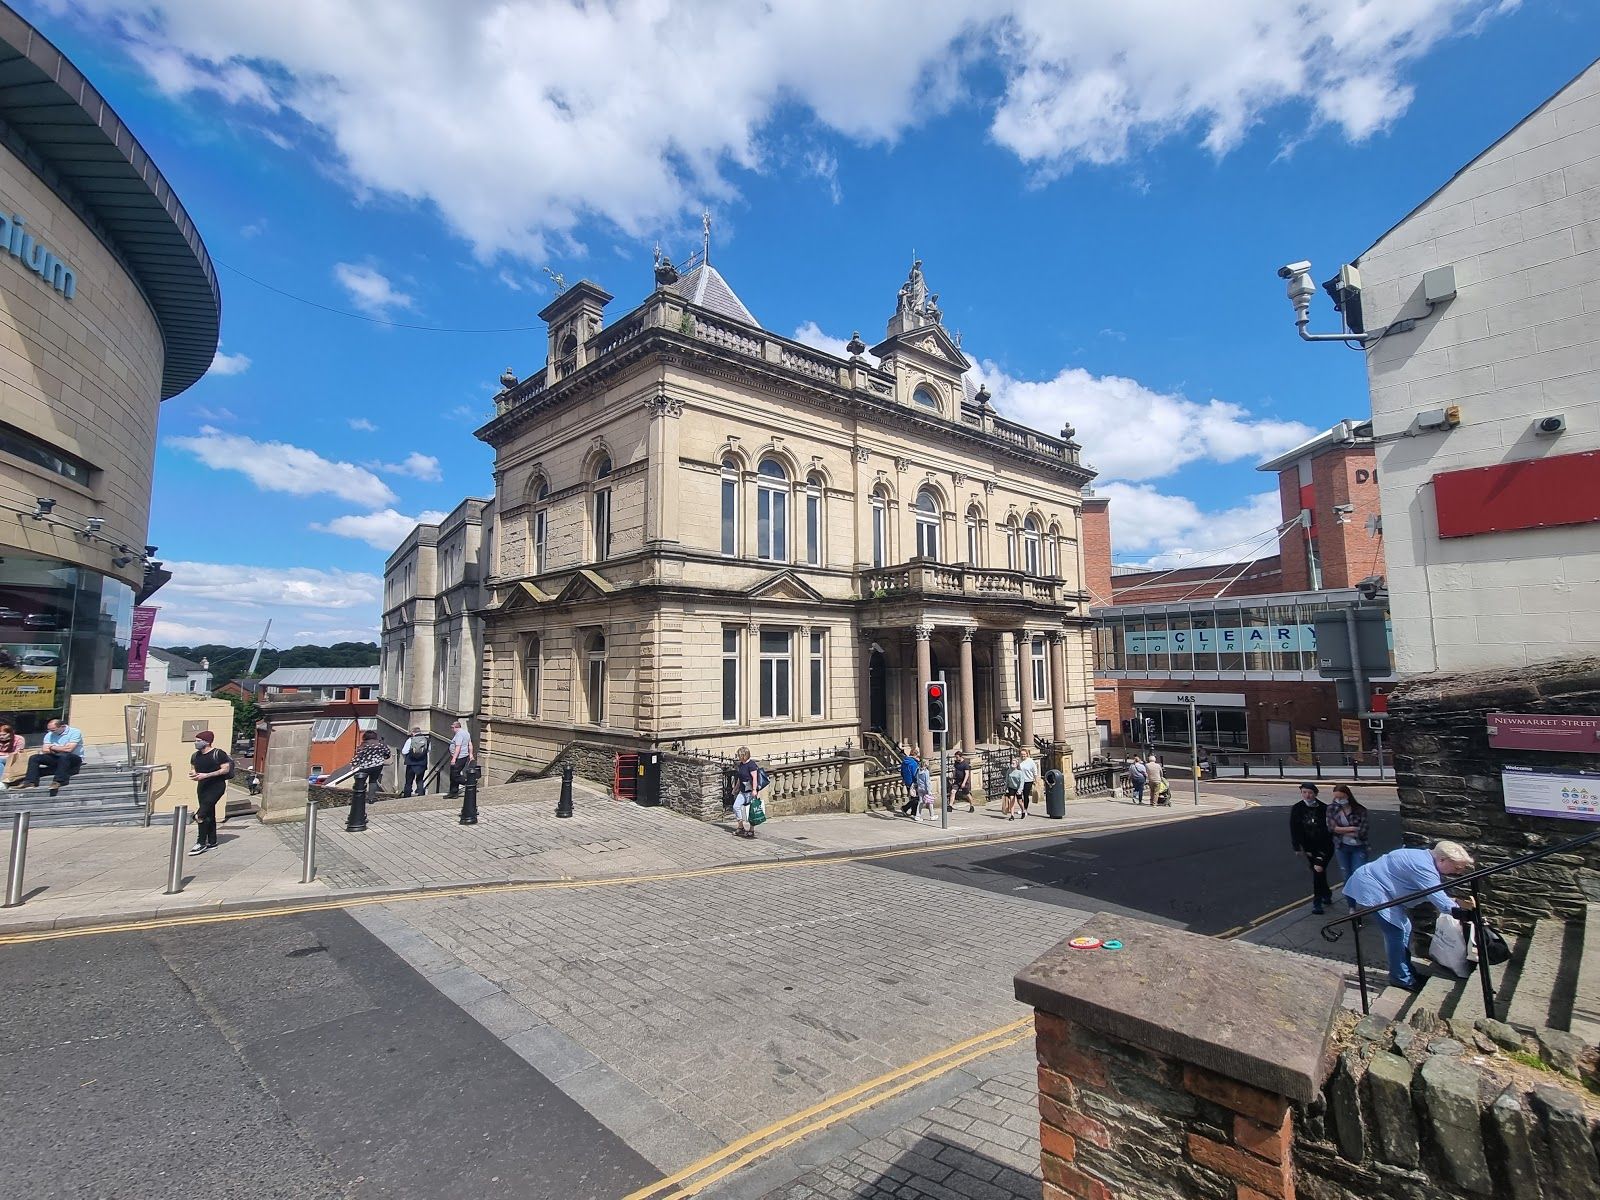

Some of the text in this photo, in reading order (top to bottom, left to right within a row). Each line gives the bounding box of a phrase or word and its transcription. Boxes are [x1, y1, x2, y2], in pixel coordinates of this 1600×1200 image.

[1177, 695, 1196, 703] M&S
[1494, 717, 1598, 727] NEWMARKET STREET
